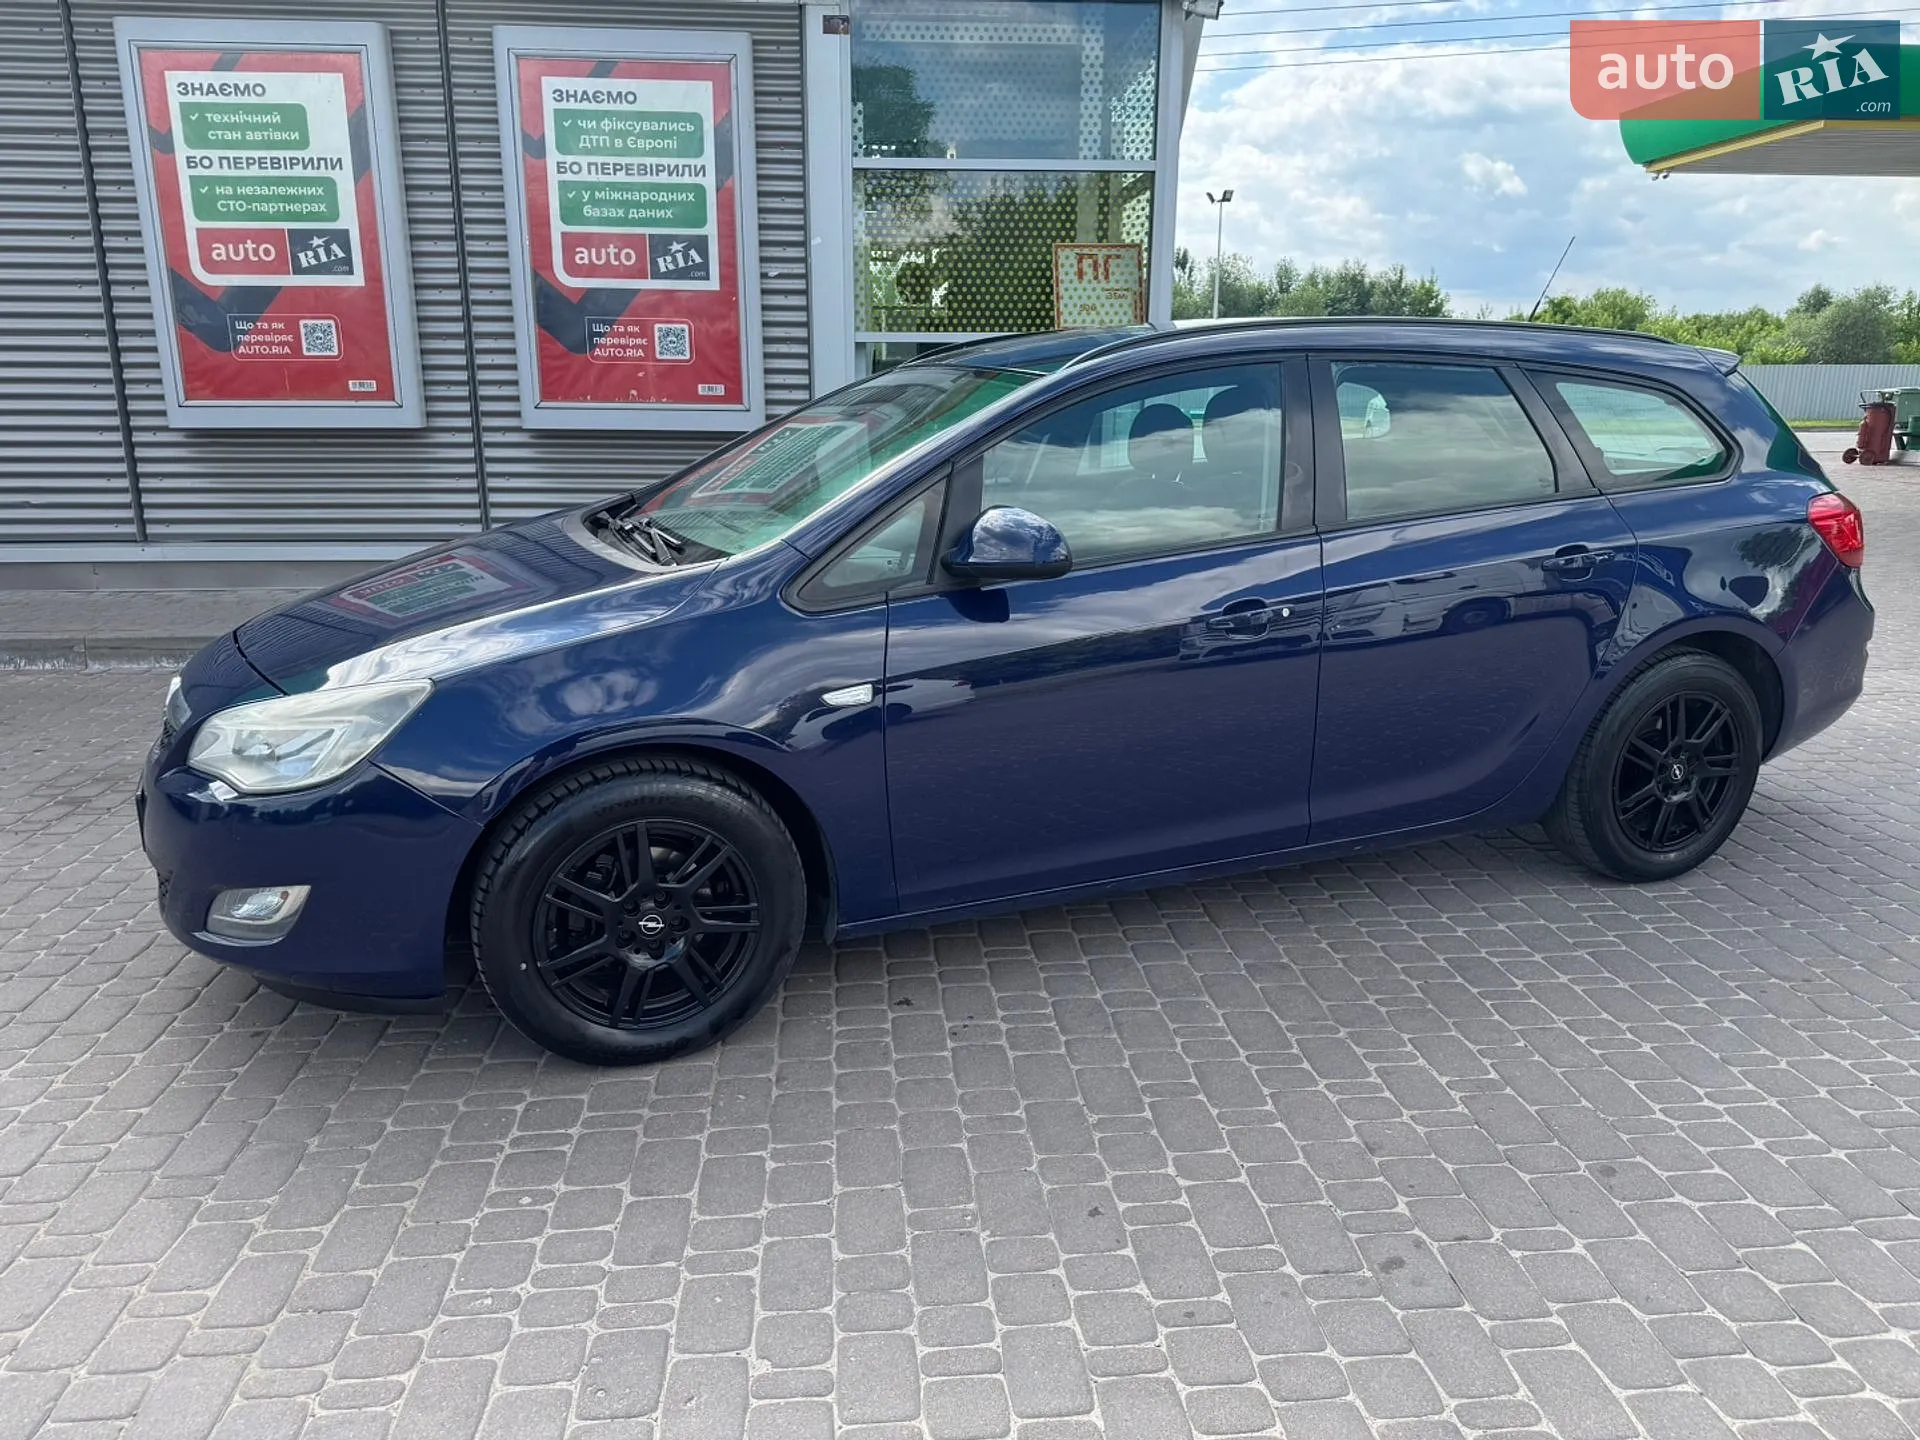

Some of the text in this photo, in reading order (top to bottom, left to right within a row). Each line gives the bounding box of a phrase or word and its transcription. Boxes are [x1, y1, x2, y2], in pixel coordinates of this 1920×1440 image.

[176, 82, 266, 97] ЗНАЄМО
[552, 88, 637, 105] ЗНАЄМО
[205, 110, 281, 124] технічний
[578, 117, 695, 133] чи фіксувались
[208, 127, 300, 141] стан автівки
[579, 135, 678, 151] ДТП в Європі
[185, 155, 343, 171] БО ПЕРЕВІРИЛИ
[556, 161, 707, 178] БО ПЕРЕВІРИЛИ
[216, 184, 325, 197] на незалежних
[582, 188, 696, 204] у міжнародних
[217, 200, 327, 215] СТО-партнерах
[583, 204, 673, 220] базах даних
[211, 239, 347, 269] auto RIA
[574, 243, 704, 273] auto RIA
[235, 320, 285, 331] Що та як
[592, 323, 640, 334] Що та як
[237, 333, 294, 345] перевіряє
[593, 335, 648, 347] перевіряє
[238, 345, 291, 355] AUTO.RIA
[593, 347, 645, 358] AUTO.RIA
